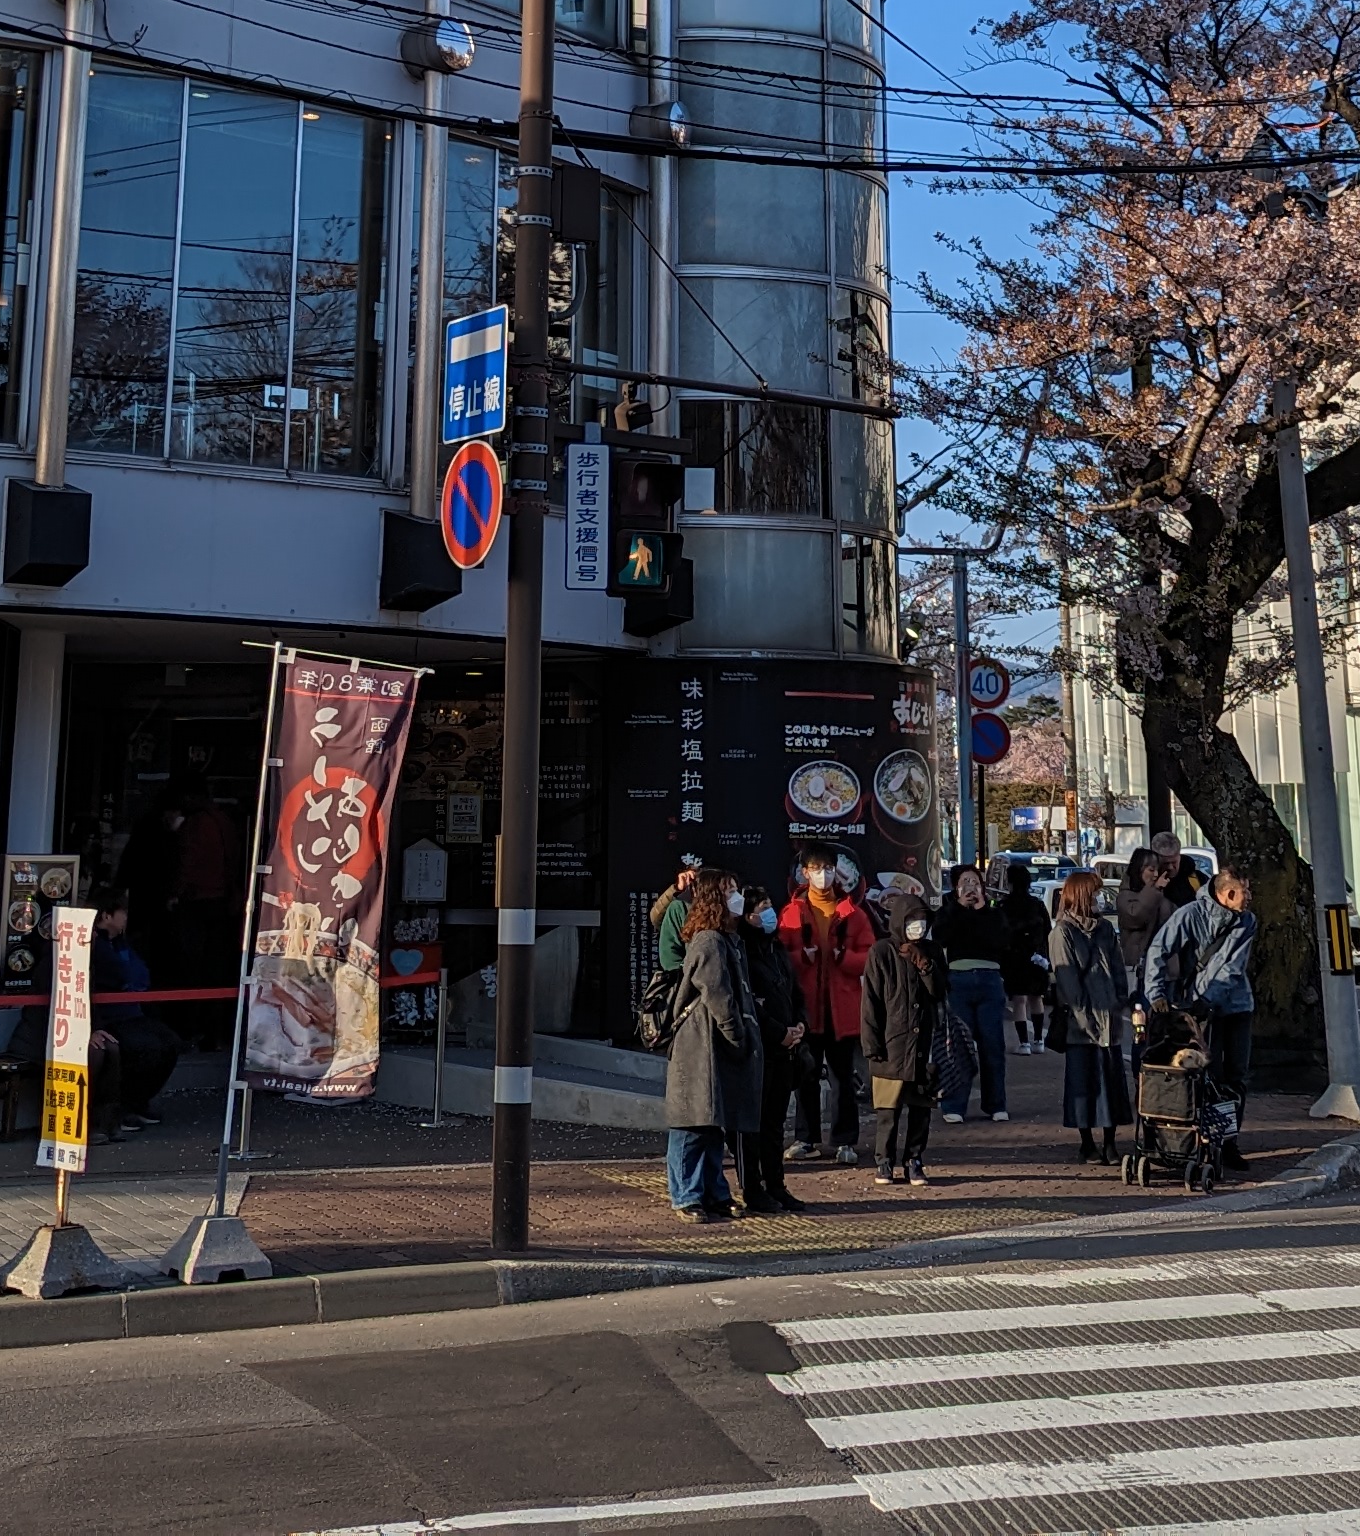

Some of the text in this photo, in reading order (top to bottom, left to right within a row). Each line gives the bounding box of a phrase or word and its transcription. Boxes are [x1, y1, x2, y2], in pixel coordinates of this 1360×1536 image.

[448, 374, 502, 422] 停止線
[575, 451, 600, 583] 歩行者支援信号
[972, 672, 1000, 695] 40
[680, 676, 704, 823] 味彩塩拉麺
[54, 921, 74, 1049] 行き止り
